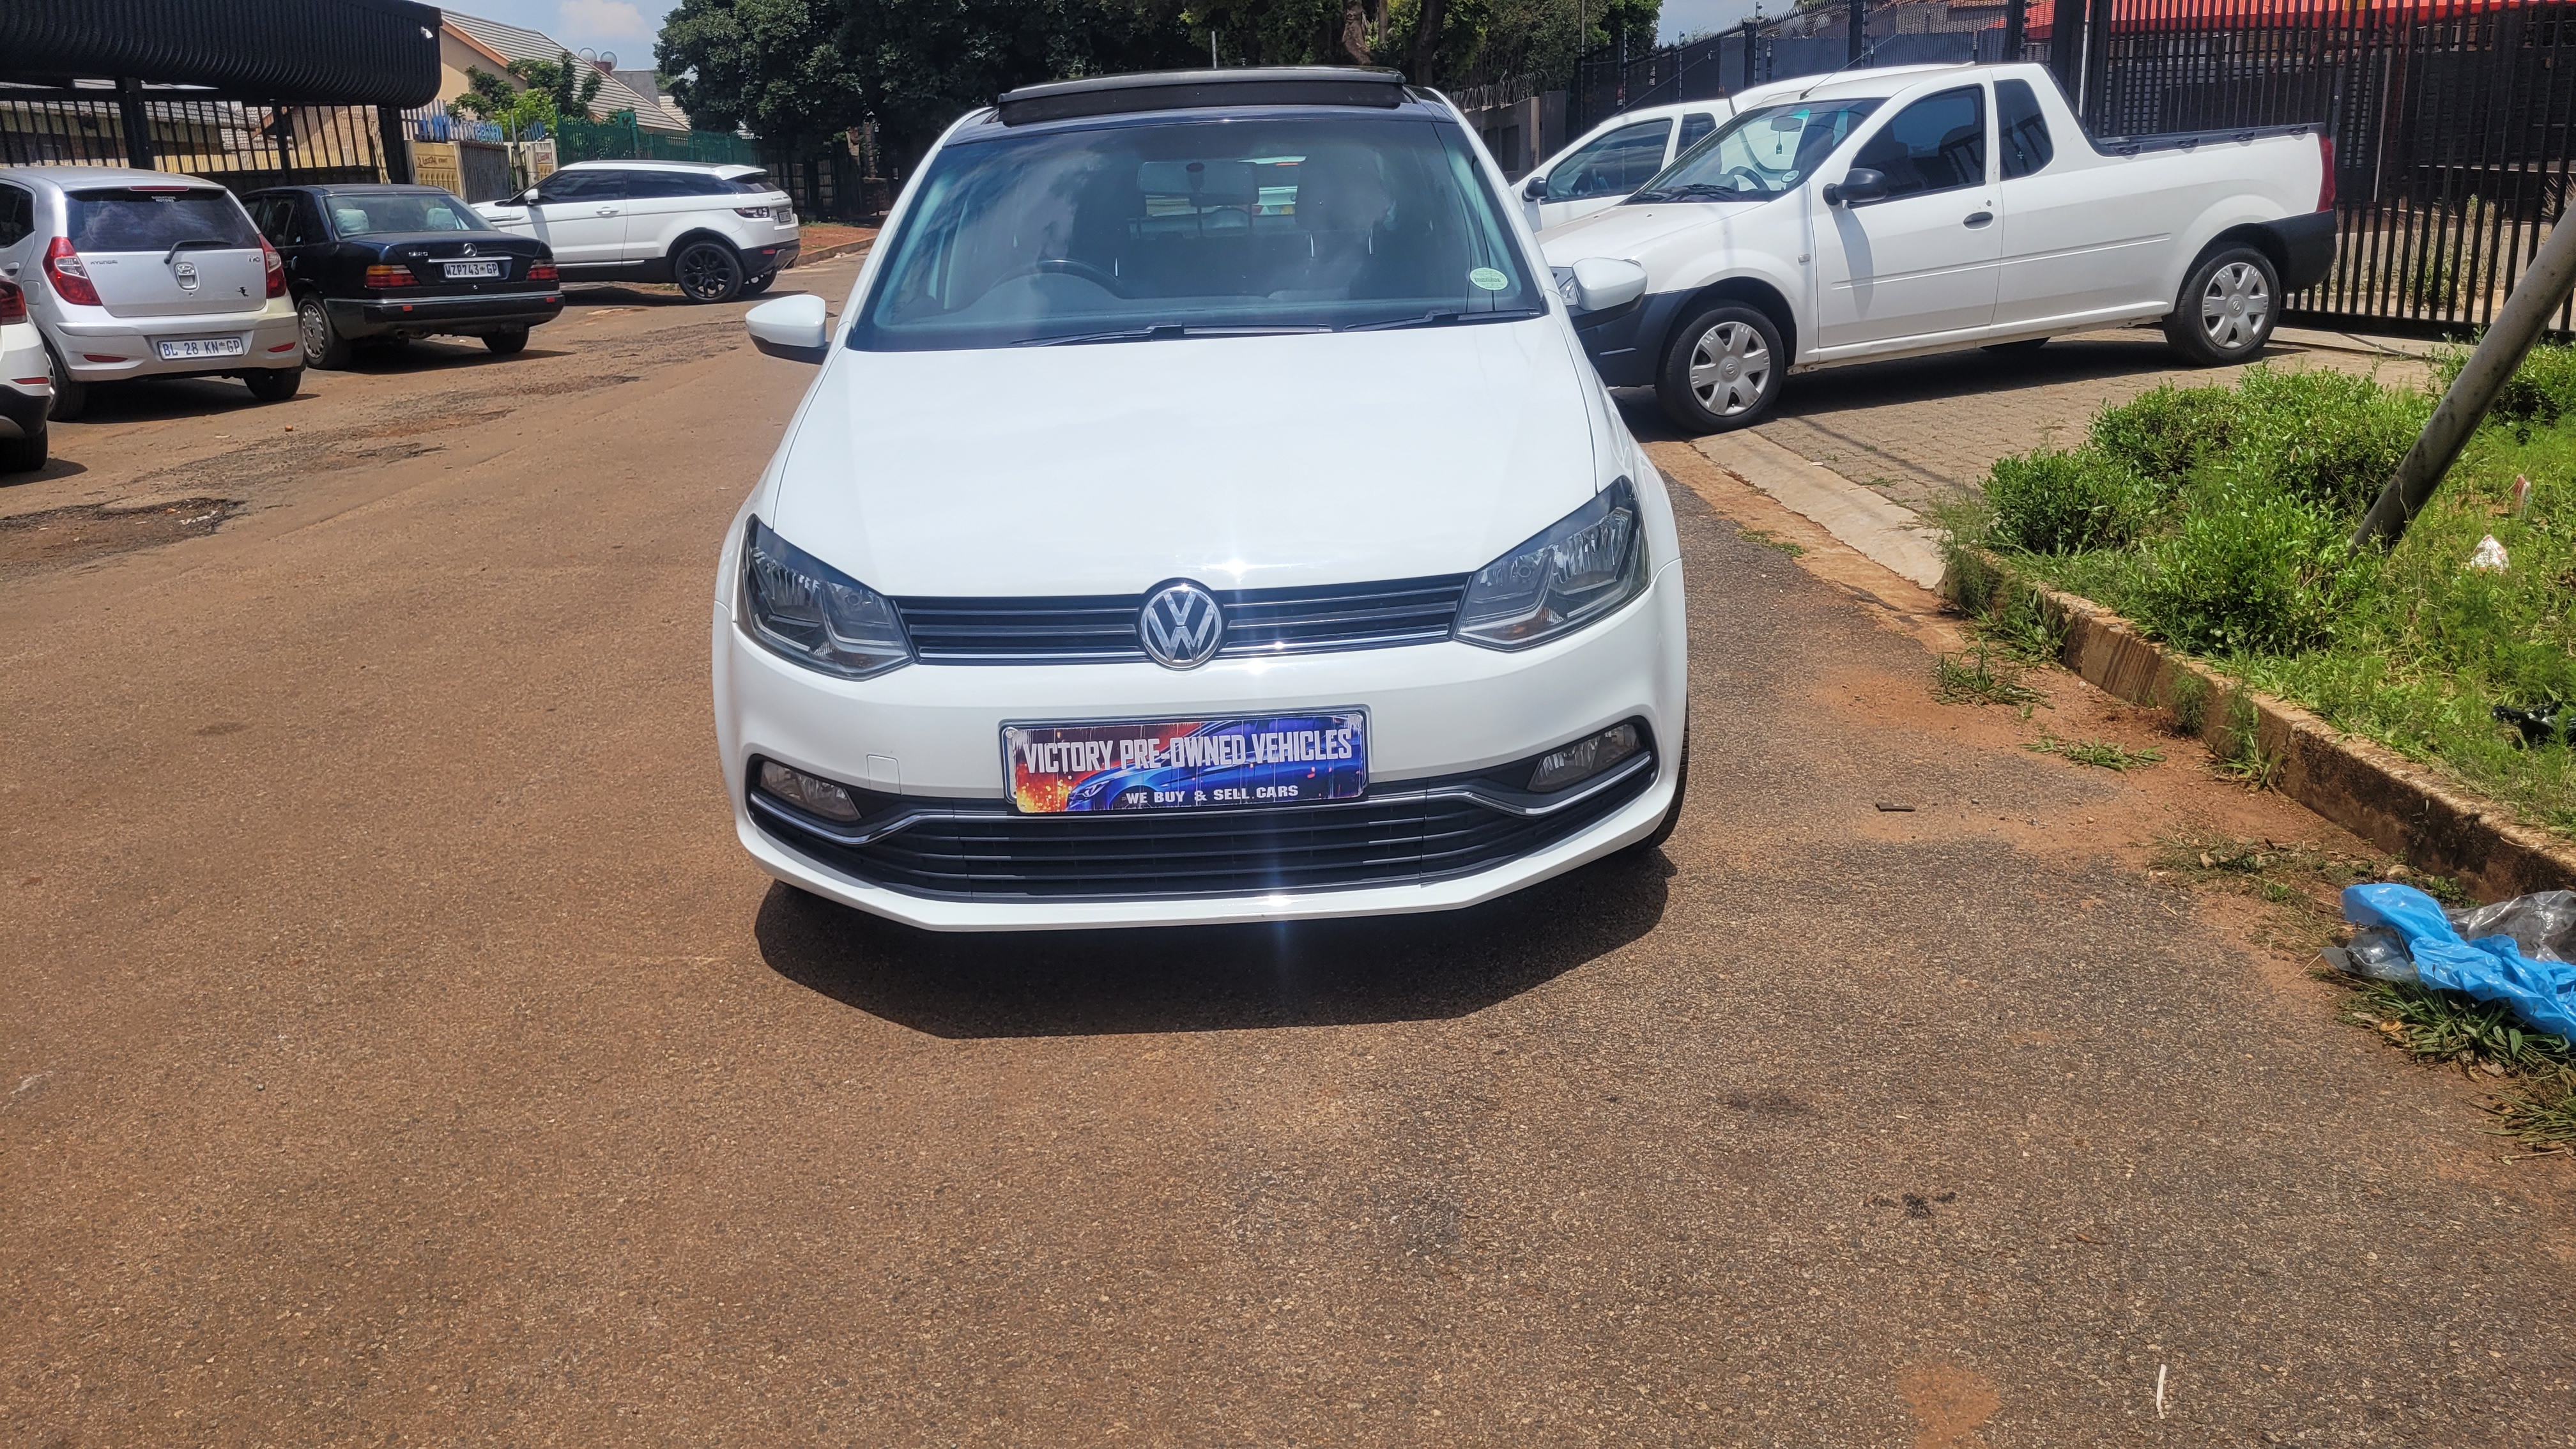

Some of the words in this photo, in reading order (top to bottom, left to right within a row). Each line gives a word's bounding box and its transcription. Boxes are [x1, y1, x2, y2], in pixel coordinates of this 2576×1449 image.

[445, 264, 479, 276] WZP743
[486, 263, 497, 274] GP
[162, 343, 178, 356] BL
[184, 342, 199, 355] 28
[204, 341, 219, 355] KN
[226, 340, 240, 353] GP
[1142, 587, 1220, 666] VW
[1023, 740, 1114, 773] VICTORY
[1119, 734, 1246, 770] PRE-OWNED
[1251, 728, 1352, 763] VEHICLES
[1126, 792, 1147, 804] WE
[1154, 790, 1185, 803] BUY
[1194, 790, 1208, 801] &
[1213, 788, 1250, 801] SELL
[1256, 785, 1299, 799] CARS
